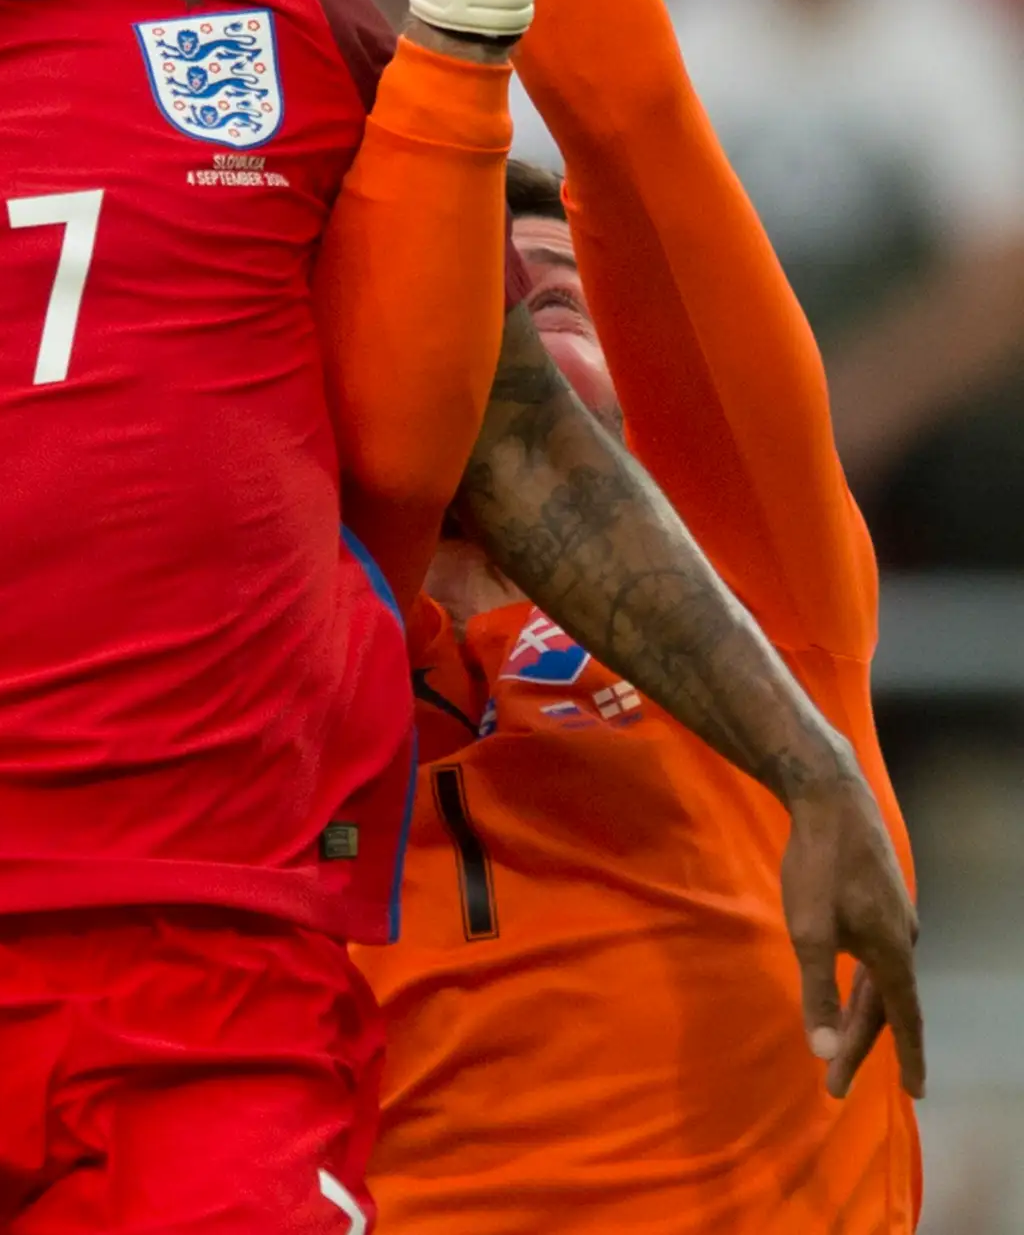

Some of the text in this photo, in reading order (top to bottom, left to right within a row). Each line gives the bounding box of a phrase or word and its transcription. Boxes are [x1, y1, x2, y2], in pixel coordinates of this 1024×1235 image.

[186, 170, 196, 186] 4
[196, 170, 264, 186] SEPTEMBER
[6, 188, 105, 385] 7
[430, 762, 500, 943] 1
